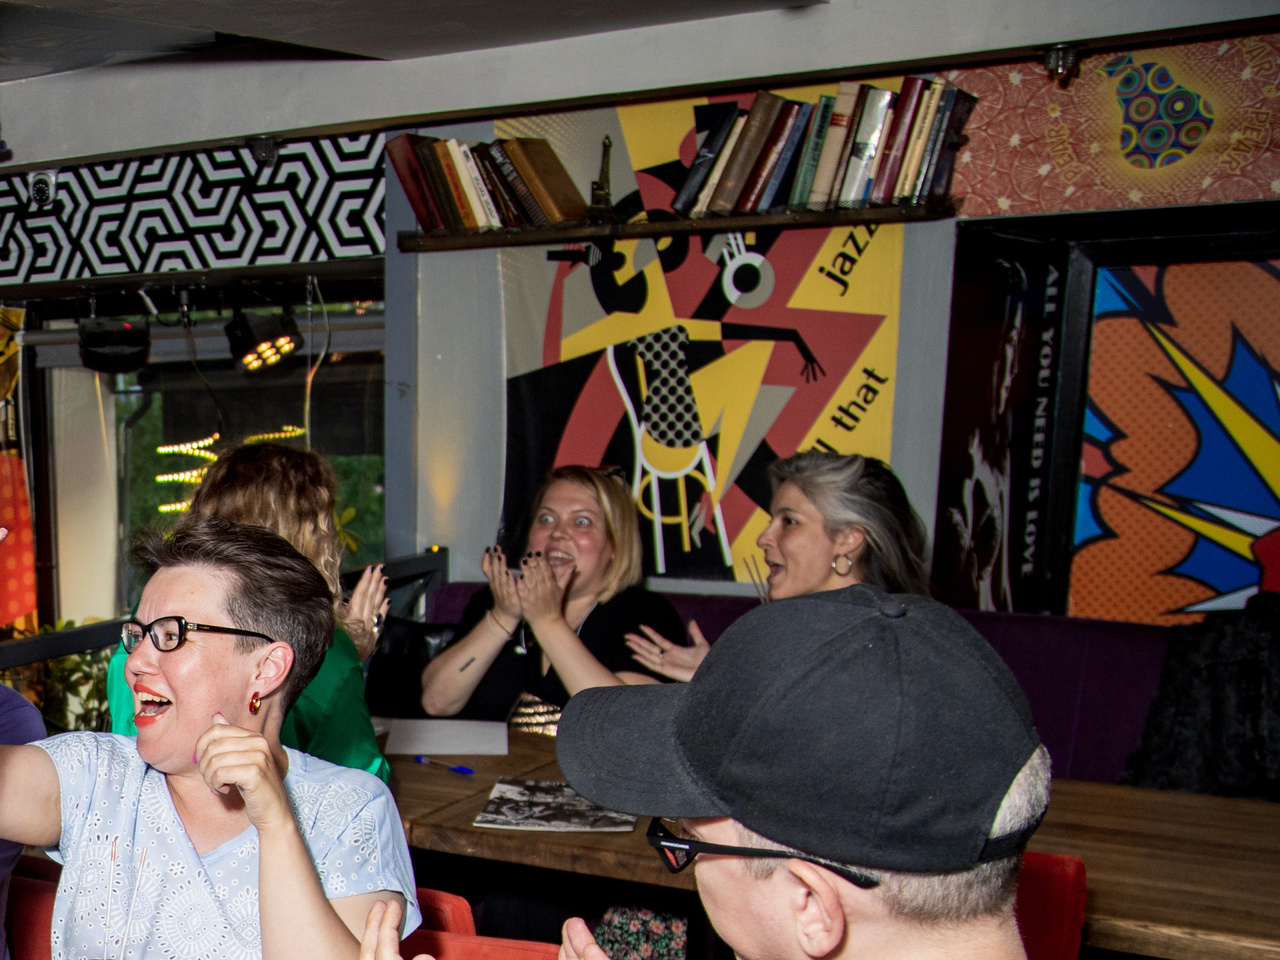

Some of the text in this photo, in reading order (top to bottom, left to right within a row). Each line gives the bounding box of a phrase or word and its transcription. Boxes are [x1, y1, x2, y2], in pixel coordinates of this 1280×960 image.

[1045, 122, 1088, 185] PEAR
[1217, 108, 1273, 174] PEAR
[818, 222, 881, 297] jazz
[830, 366, 889, 432] that
[1021, 264, 1060, 578] ALL YOU NEED IS LOVE
